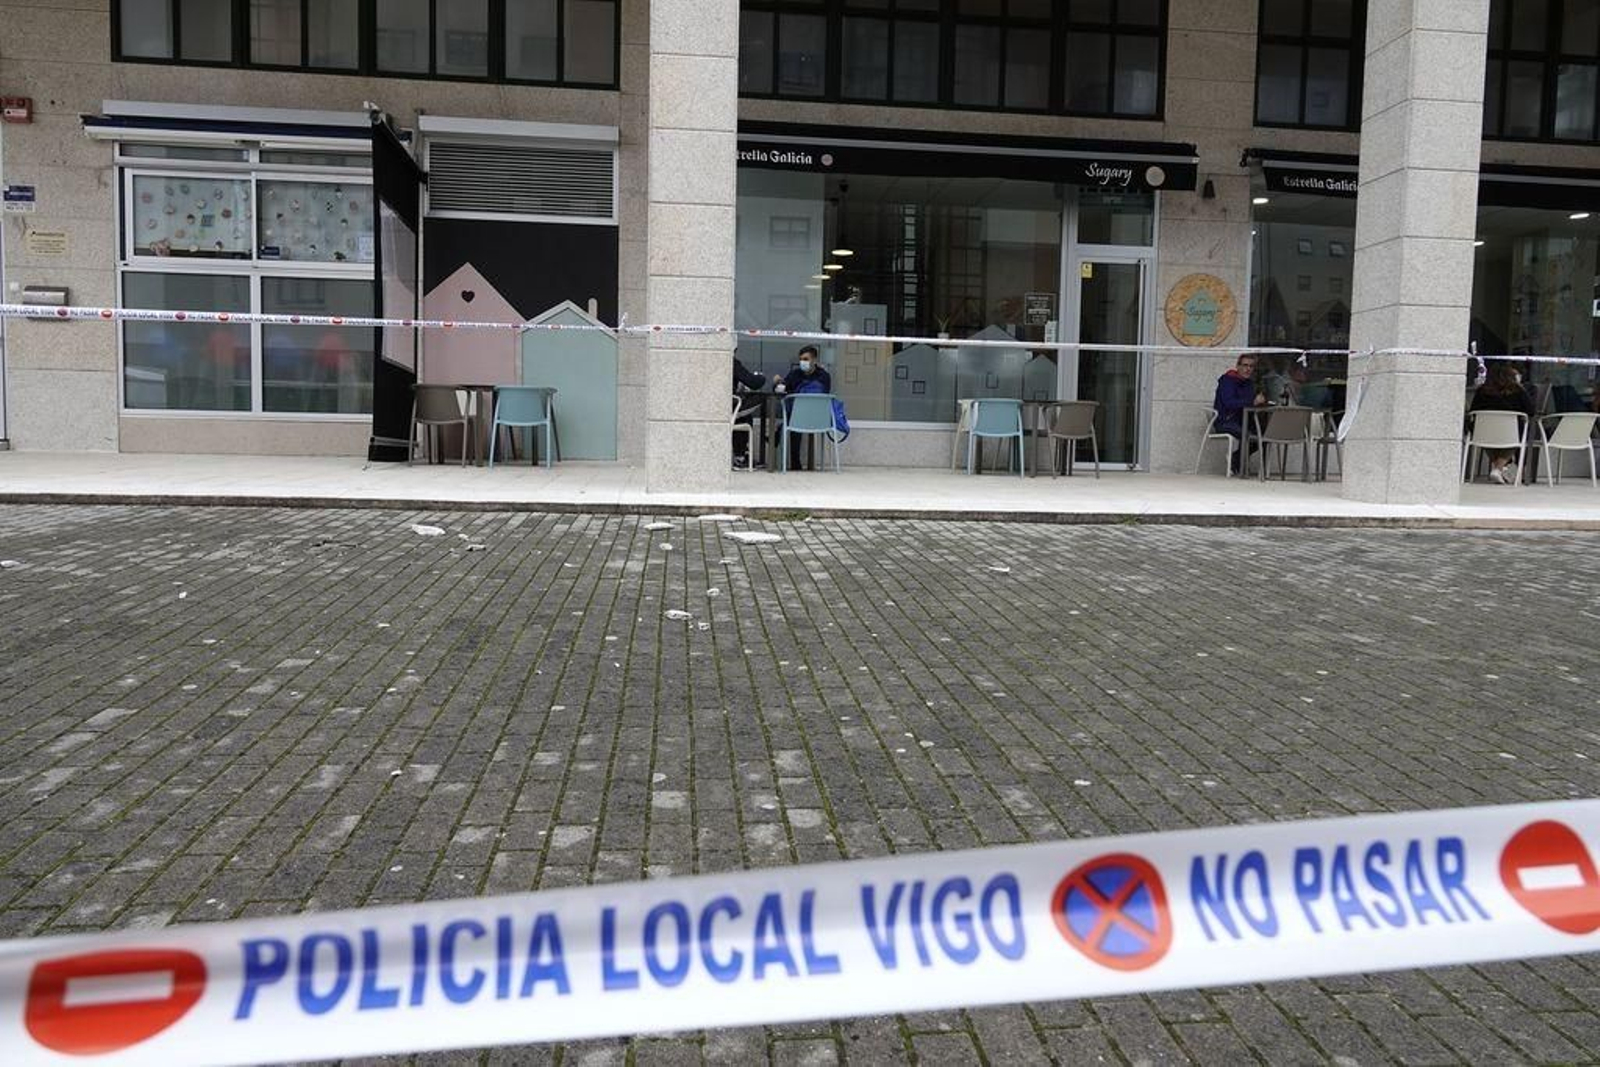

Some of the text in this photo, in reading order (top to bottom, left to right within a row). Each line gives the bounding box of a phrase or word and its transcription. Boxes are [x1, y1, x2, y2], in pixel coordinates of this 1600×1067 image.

[737, 149, 813, 165] trella Galicia
[1084, 162, 1132, 187] Sugary
[1283, 176, 1358, 192] Estrella Galici
[235, 836, 1493, 1021] POLICIA LOCAL VIGO NO PASAR
